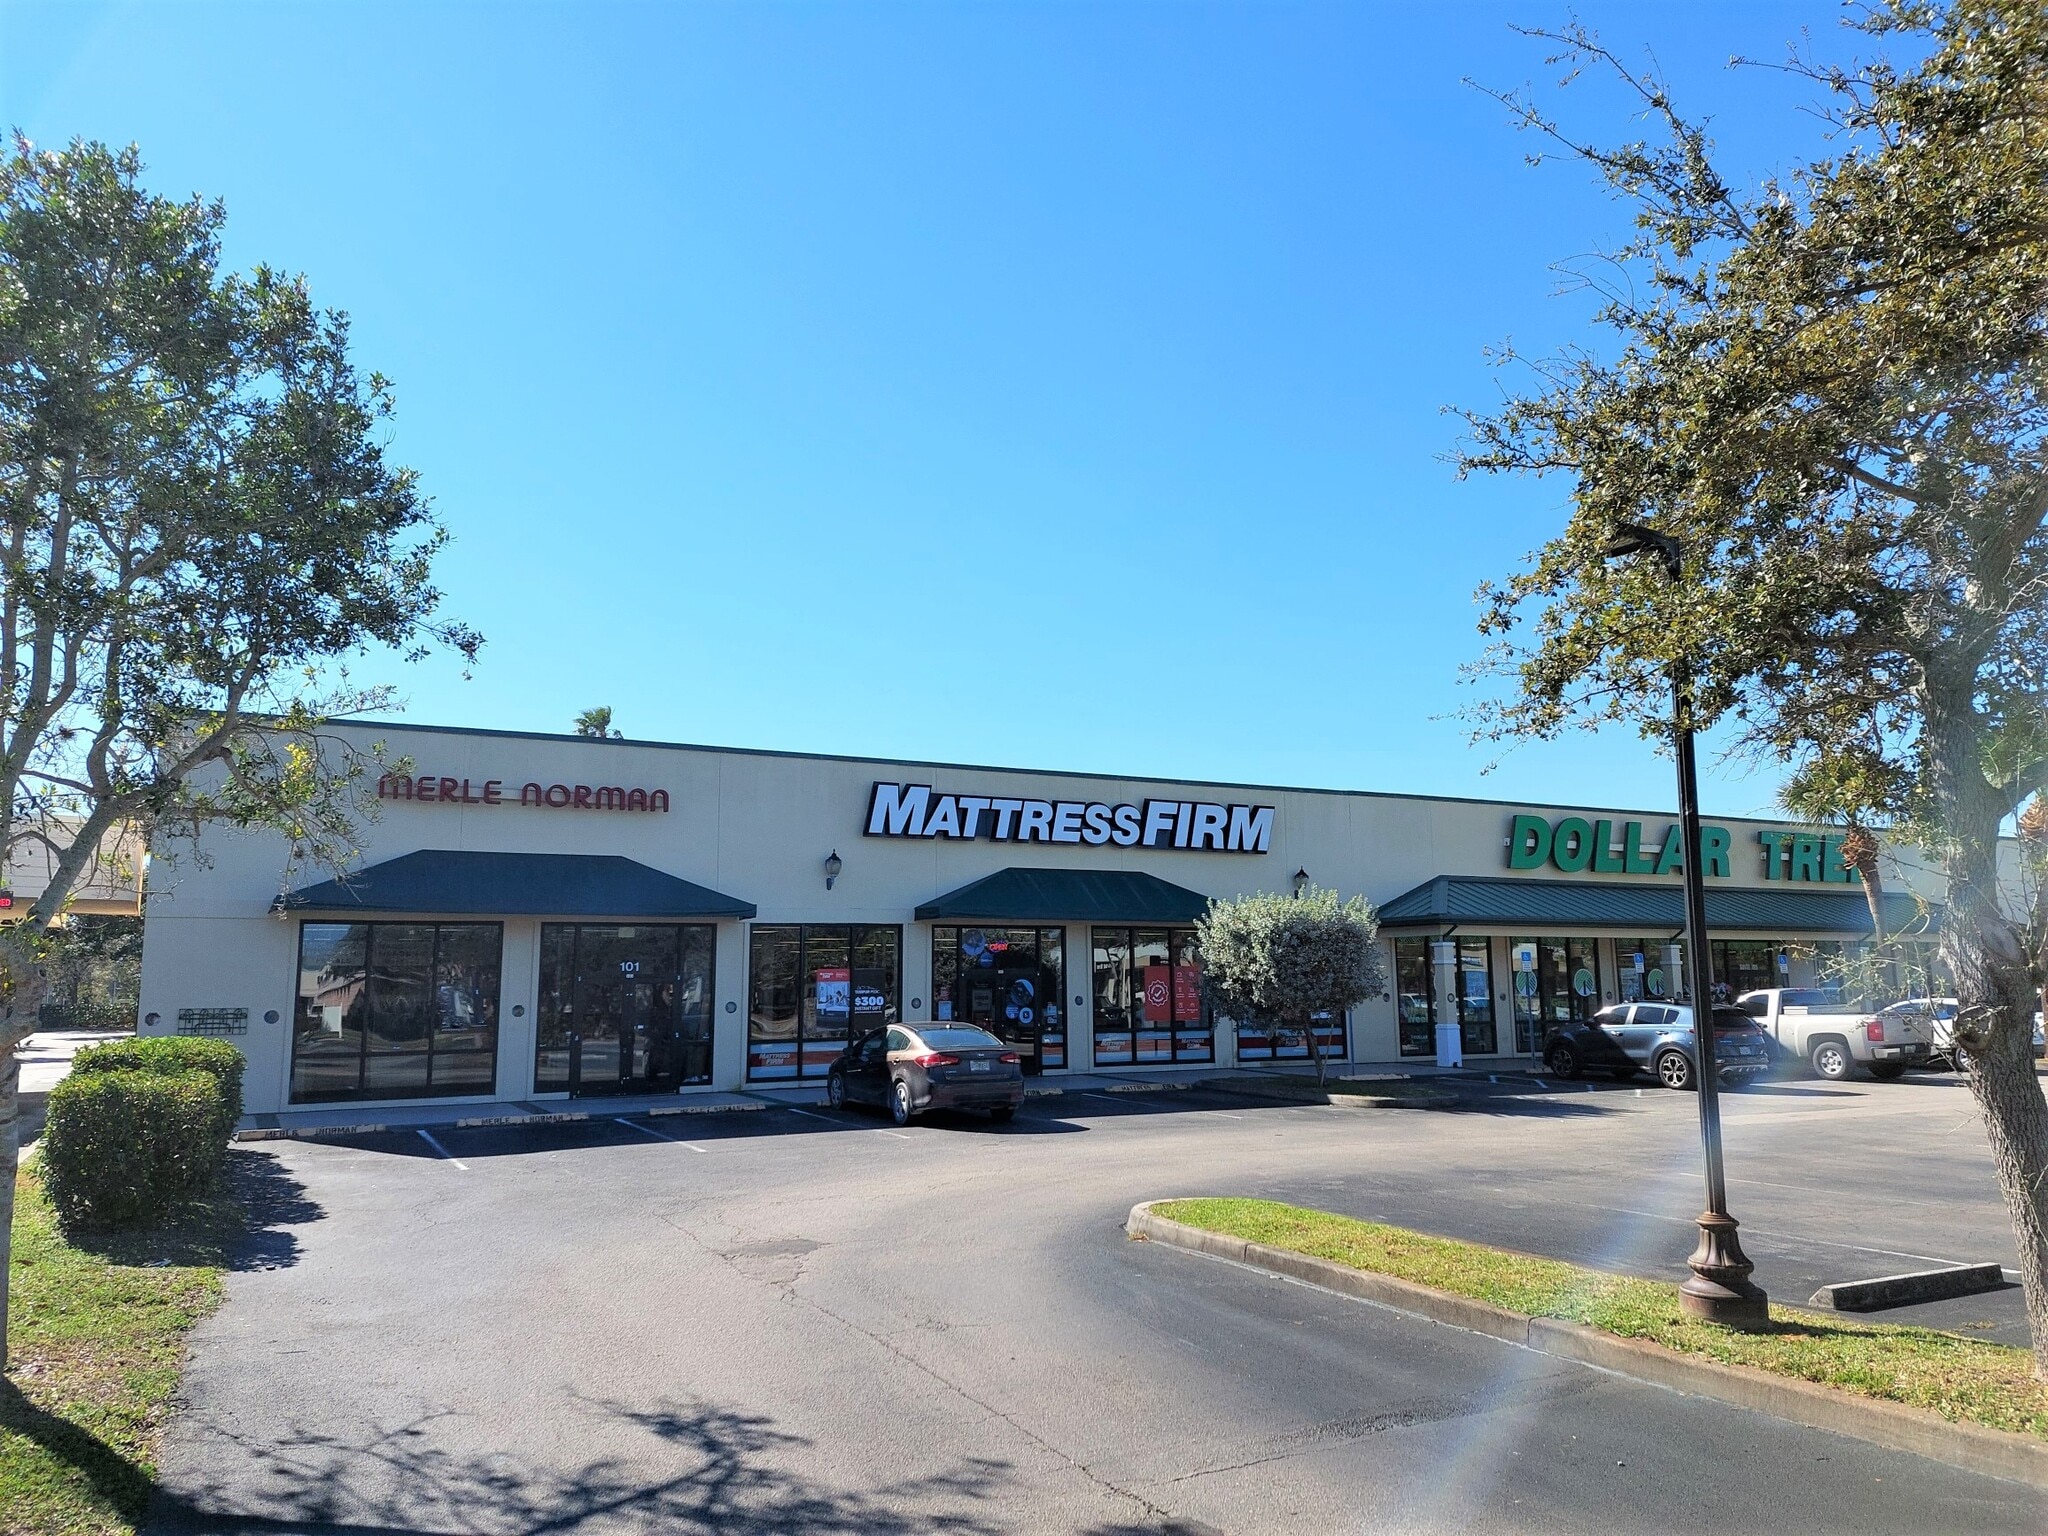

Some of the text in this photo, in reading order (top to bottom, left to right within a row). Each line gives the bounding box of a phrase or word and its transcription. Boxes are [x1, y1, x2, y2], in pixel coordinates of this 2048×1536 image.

[377, 774, 670, 813] MERLE NORMAN
[1508, 815, 1861, 883] DOLLAR TRE
[619, 961, 640, 972] 101
[854, 996, 884, 1006] $300
